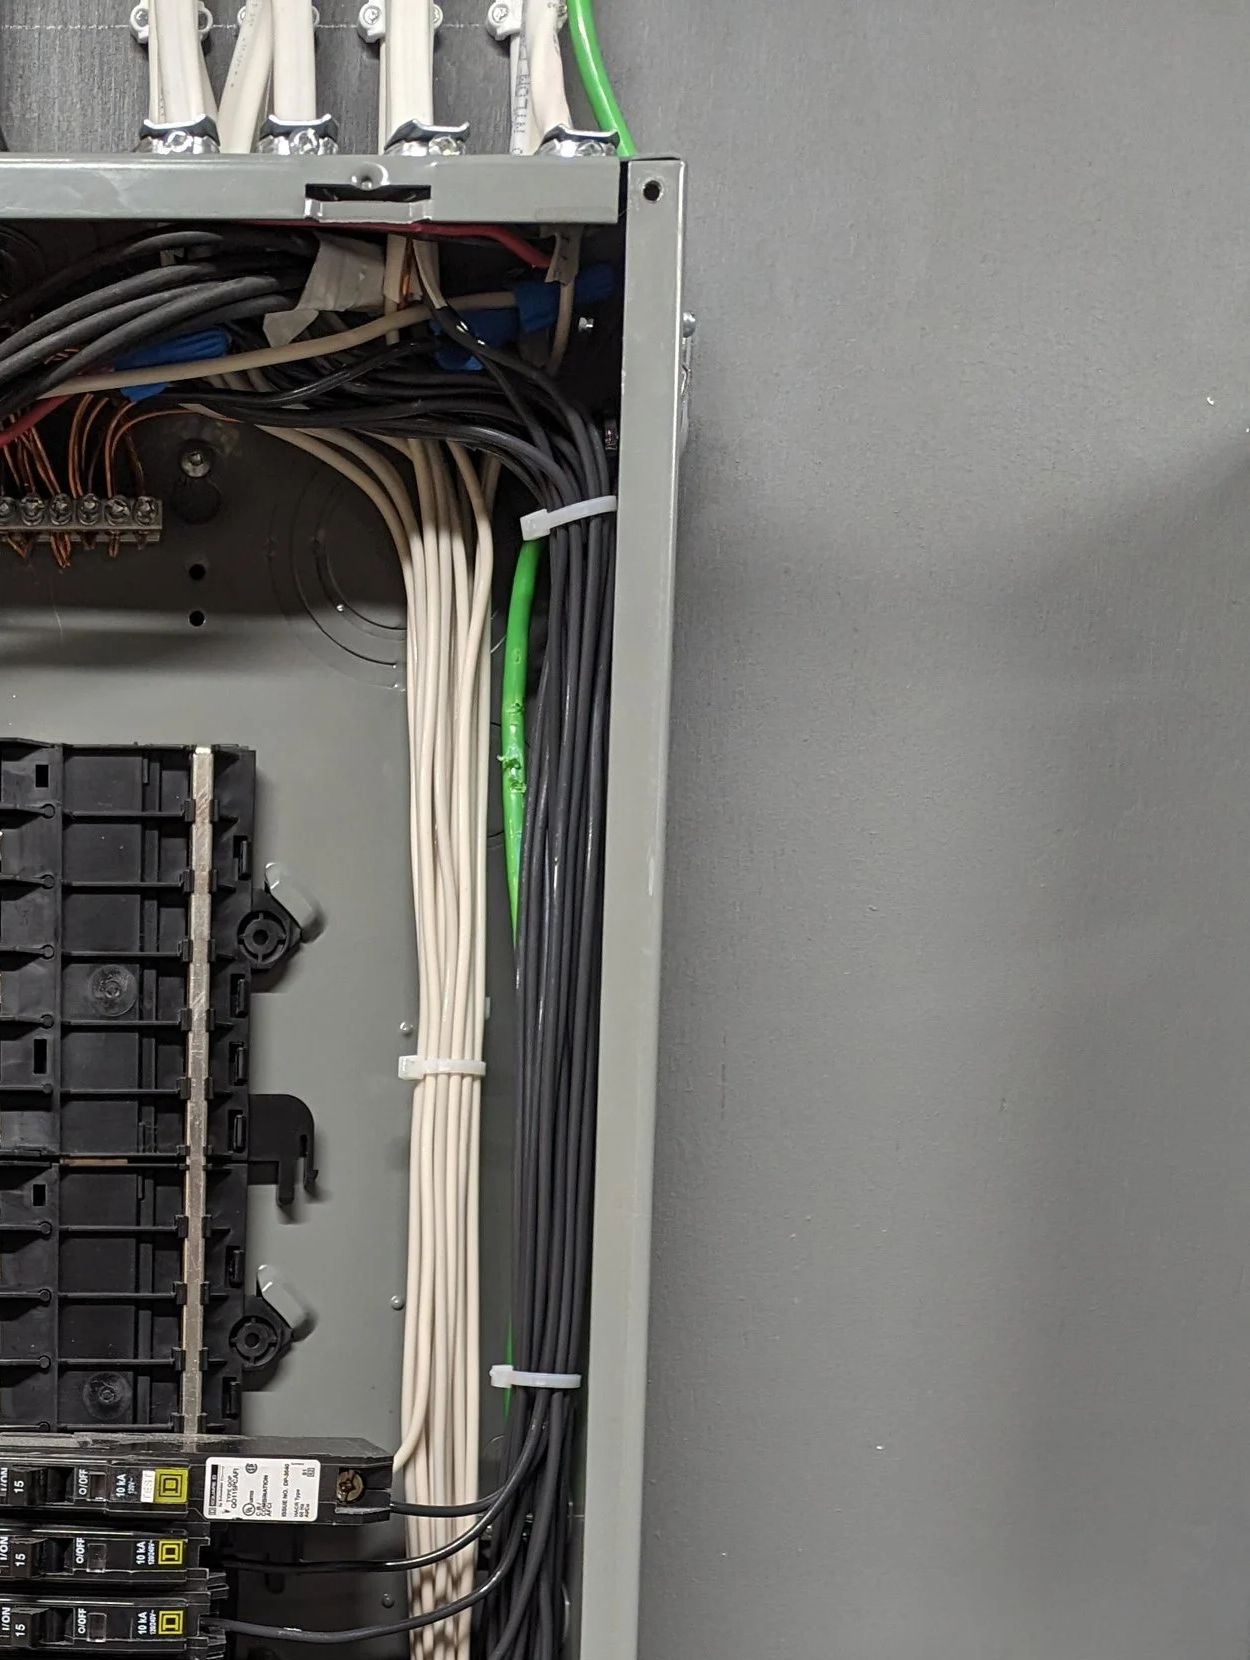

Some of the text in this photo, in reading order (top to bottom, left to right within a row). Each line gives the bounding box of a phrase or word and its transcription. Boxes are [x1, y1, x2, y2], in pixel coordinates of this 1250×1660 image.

[14, 1480, 23, 1493] 15
[16, 1553, 25, 1566] 15
[16, 1623, 25, 1636] 15
